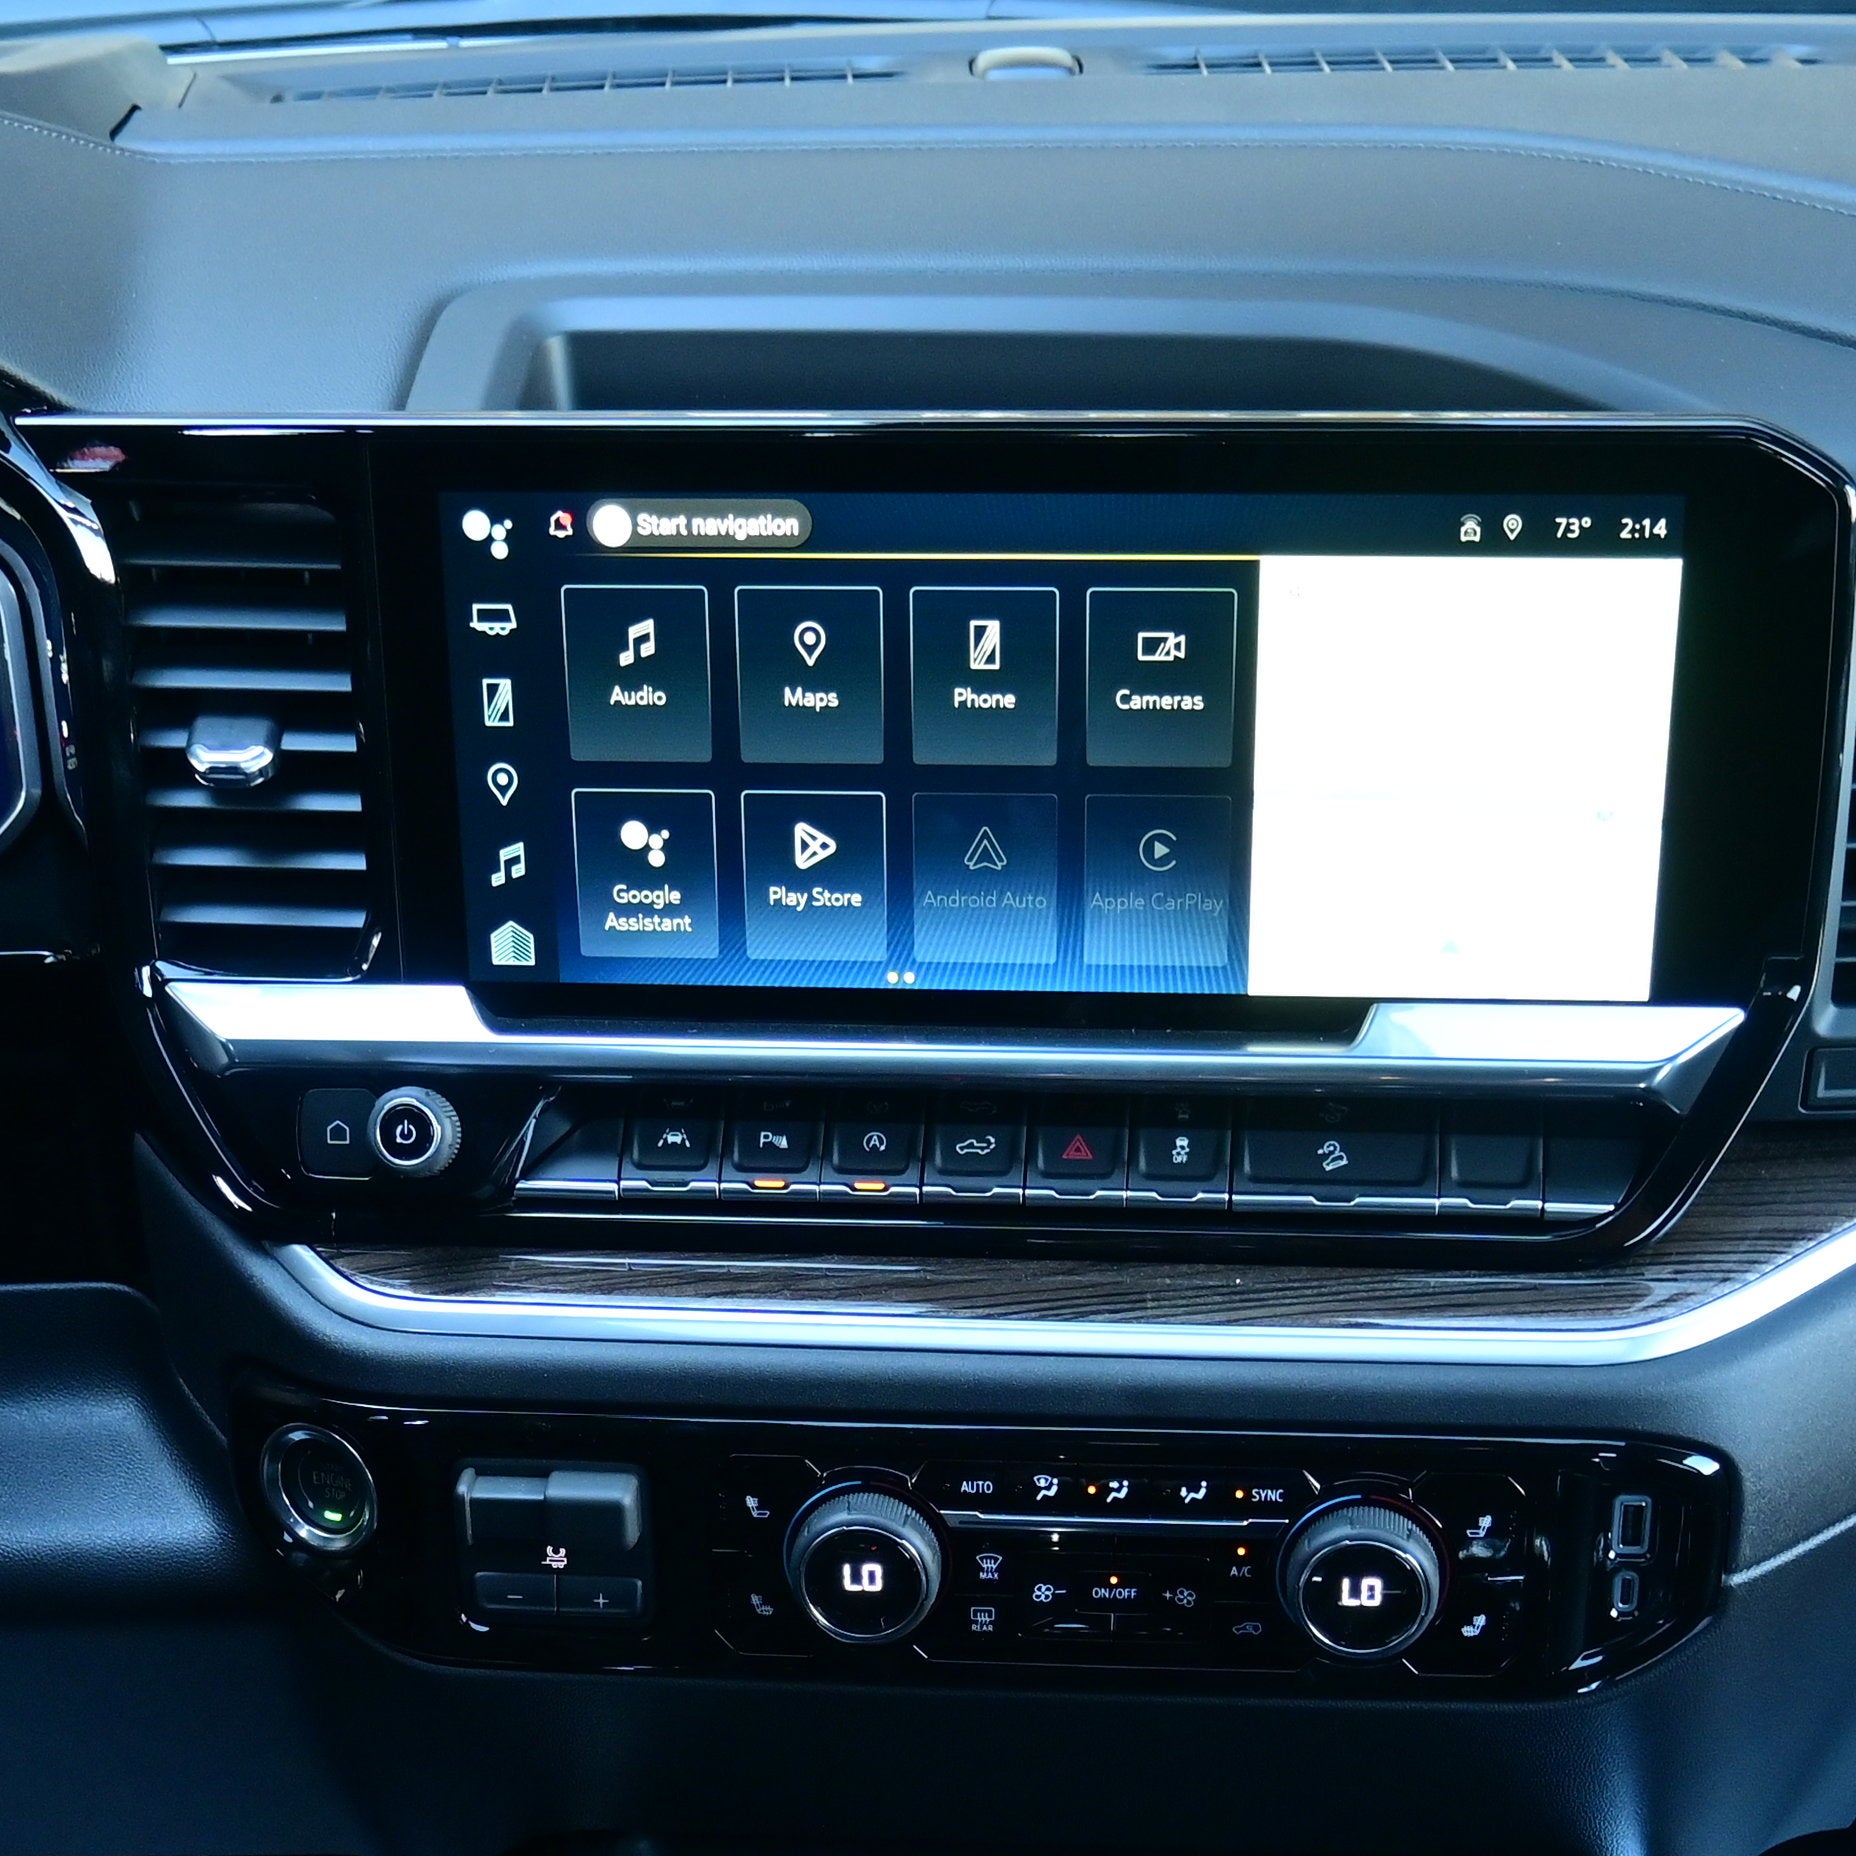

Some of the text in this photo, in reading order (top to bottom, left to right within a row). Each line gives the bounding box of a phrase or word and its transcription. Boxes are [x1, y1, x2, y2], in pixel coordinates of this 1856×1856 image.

[637, 512, 800, 541] Start navigation
[1619, 517, 1667, 539] 2:14
[609, 686, 667, 707] Audio
[783, 688, 840, 712] Maps
[953, 688, 1016, 710] Phone
[1115, 690, 1205, 711] Cameras
[612, 885, 682, 909] Google
[768, 886, 863, 911] Play Store
[922, 889, 1048, 910] Android Auto
[1090, 892, 1224, 917] Apple CarPlay
[604, 912, 693, 934] Assistant
[1173, 1154, 1188, 1164] OFF
[961, 1481, 993, 1494] AUTO
[1251, 1489, 1284, 1502] SYNC
[980, 1571, 999, 1580] MAX
[1230, 1566, 1252, 1578] A/C
[1092, 1588, 1137, 1600] ON/OFF
